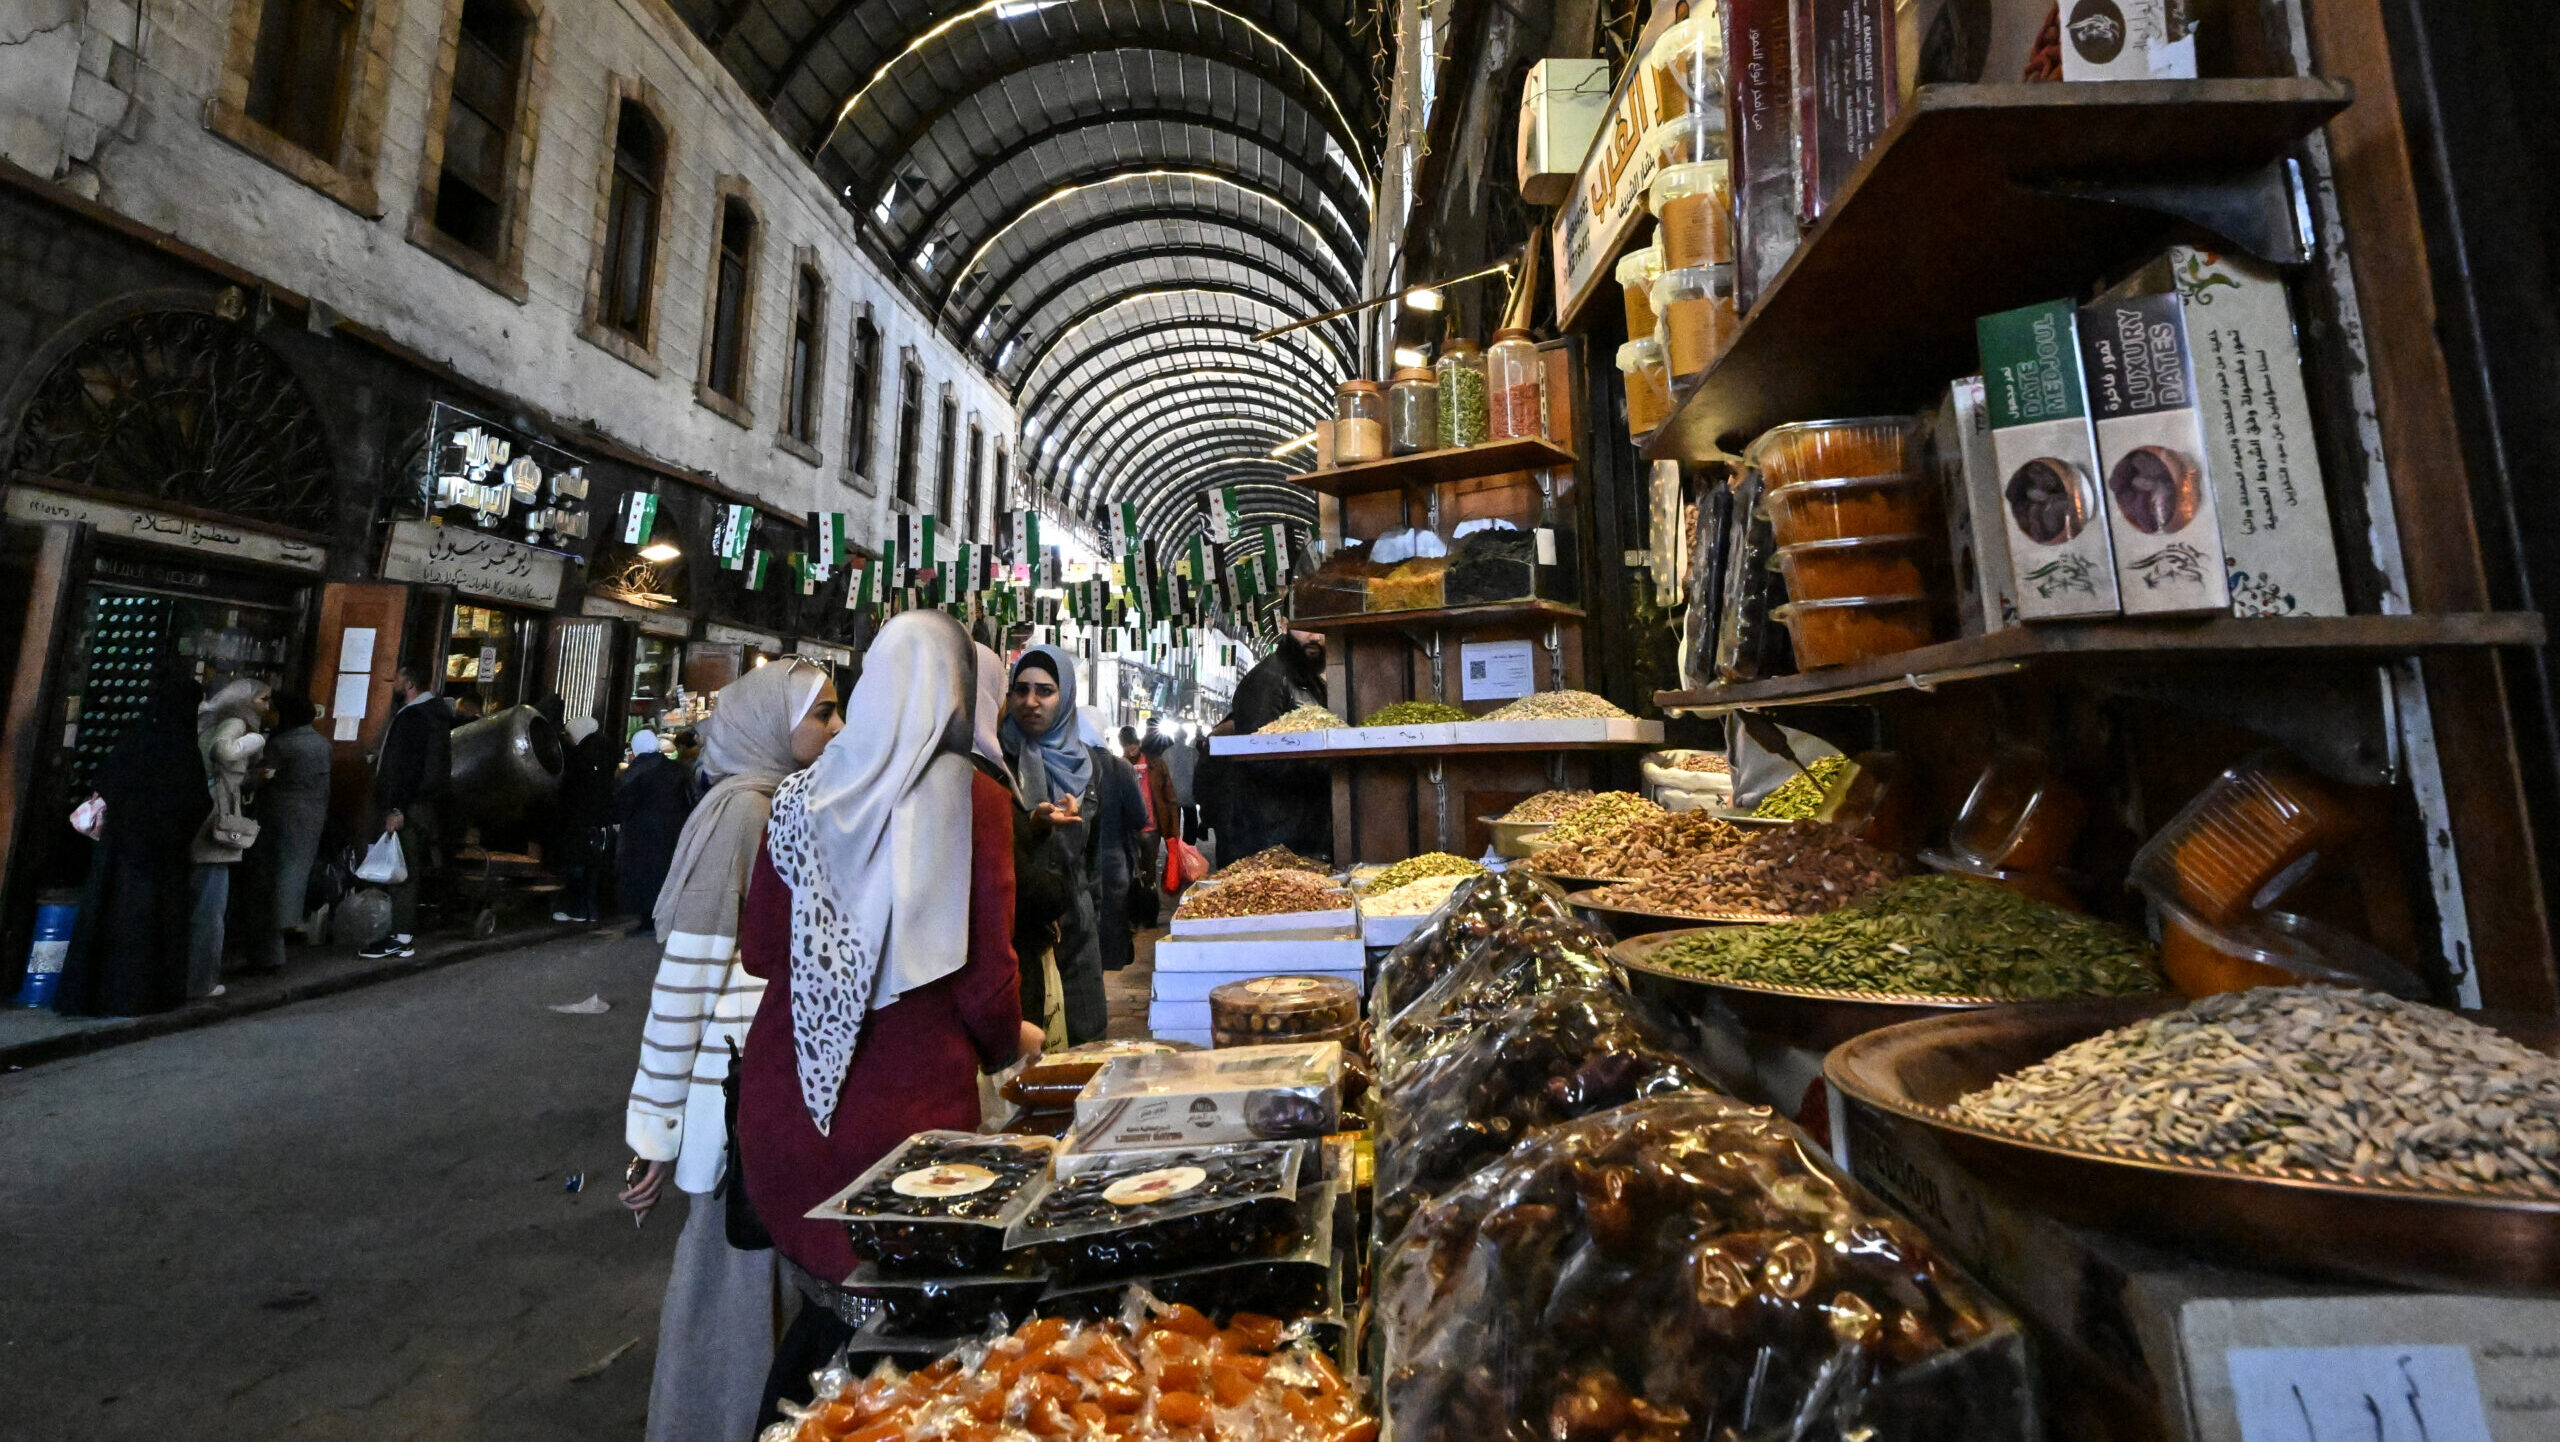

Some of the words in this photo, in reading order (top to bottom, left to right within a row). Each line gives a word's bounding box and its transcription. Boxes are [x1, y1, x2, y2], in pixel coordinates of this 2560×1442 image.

[2033, 312, 2067, 415] MEDJOUL
[2096, 339, 2117, 370] تمور
[2116, 308, 2157, 409] LUXURY
[2149, 322, 2186, 405] DATES
[2016, 359, 2043, 417] DATE
[2101, 373, 2122, 412] فاخرة
[2227, 330, 2246, 355] تمور
[2247, 439, 2268, 482] الشروط
[2258, 487, 2278, 531] الصحية
[131, 513, 188, 536] السلام
[191, 524, 241, 546] معطرة
